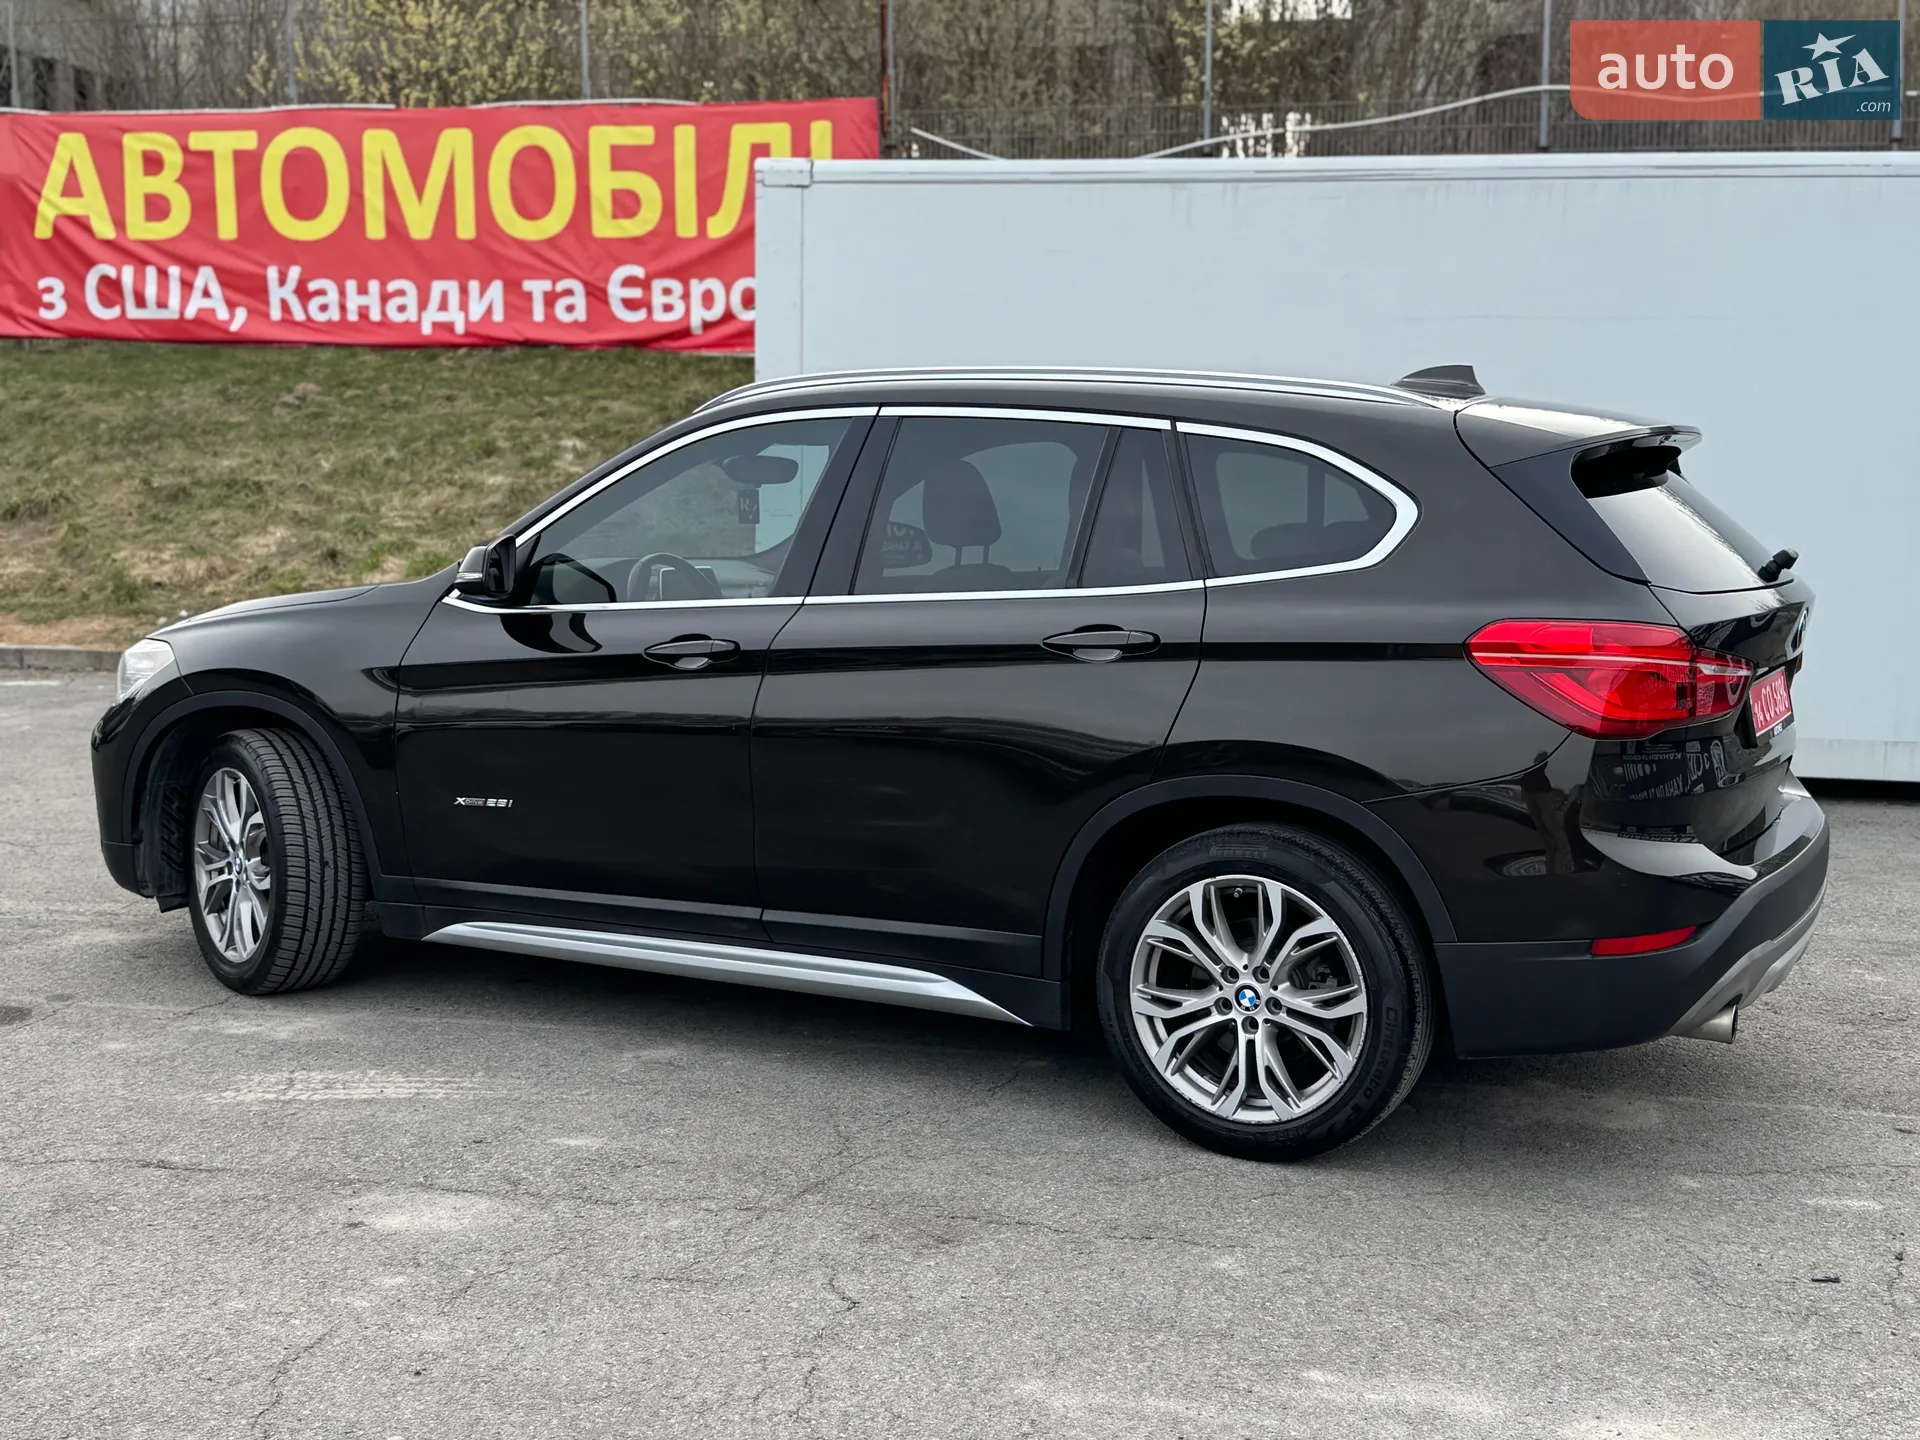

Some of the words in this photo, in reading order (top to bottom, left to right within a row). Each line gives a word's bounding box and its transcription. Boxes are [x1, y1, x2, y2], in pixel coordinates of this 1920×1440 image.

[36, 276, 68, 320] з
[84, 263, 248, 333] США,
[266, 264, 504, 335] Канади
[522, 277, 588, 323] та
